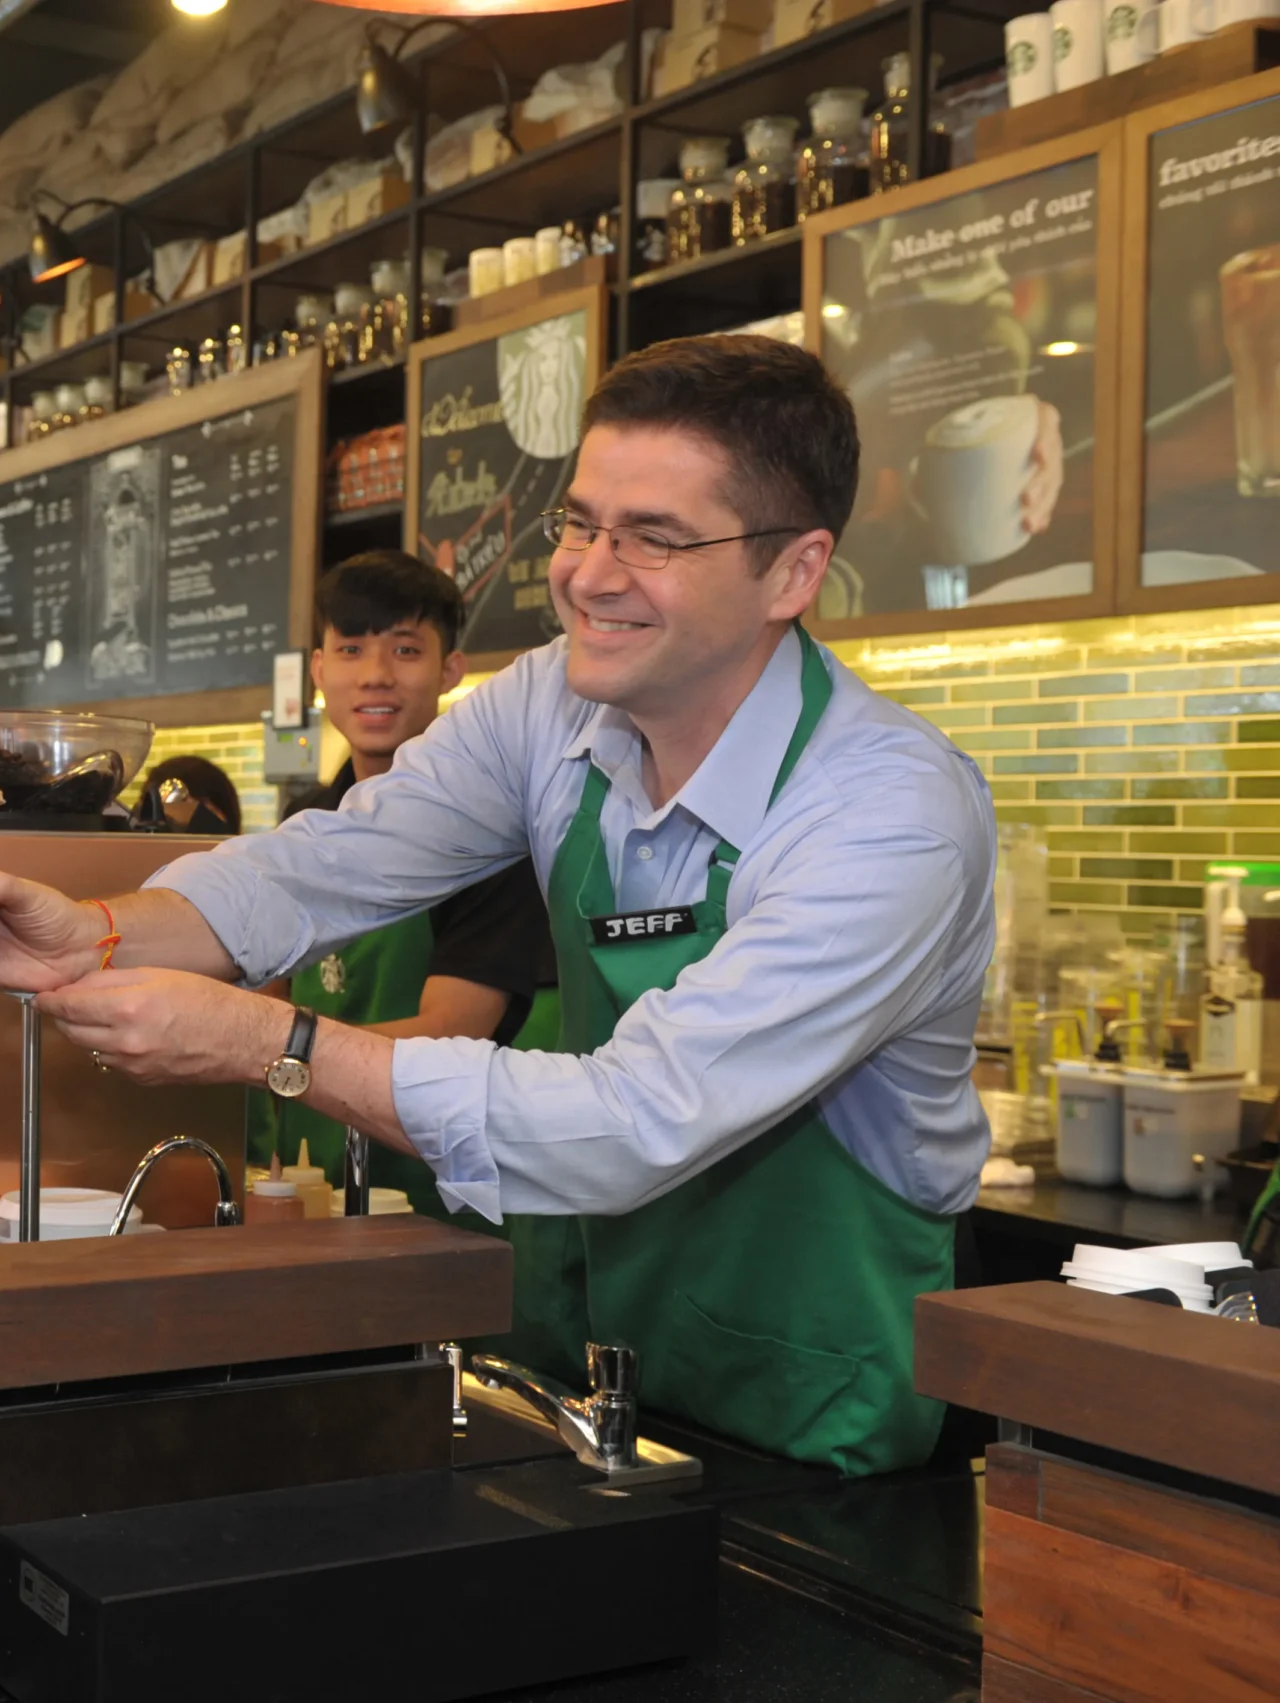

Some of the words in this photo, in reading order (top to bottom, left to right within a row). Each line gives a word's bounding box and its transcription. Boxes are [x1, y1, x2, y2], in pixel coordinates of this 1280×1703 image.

[1159, 135, 1280, 187] favorite
[890, 229, 955, 262] Make
[959, 214, 1005, 243] one
[1009, 198, 1039, 228] of
[1045, 188, 1095, 218] our
[606, 912, 684, 938] JEFF
